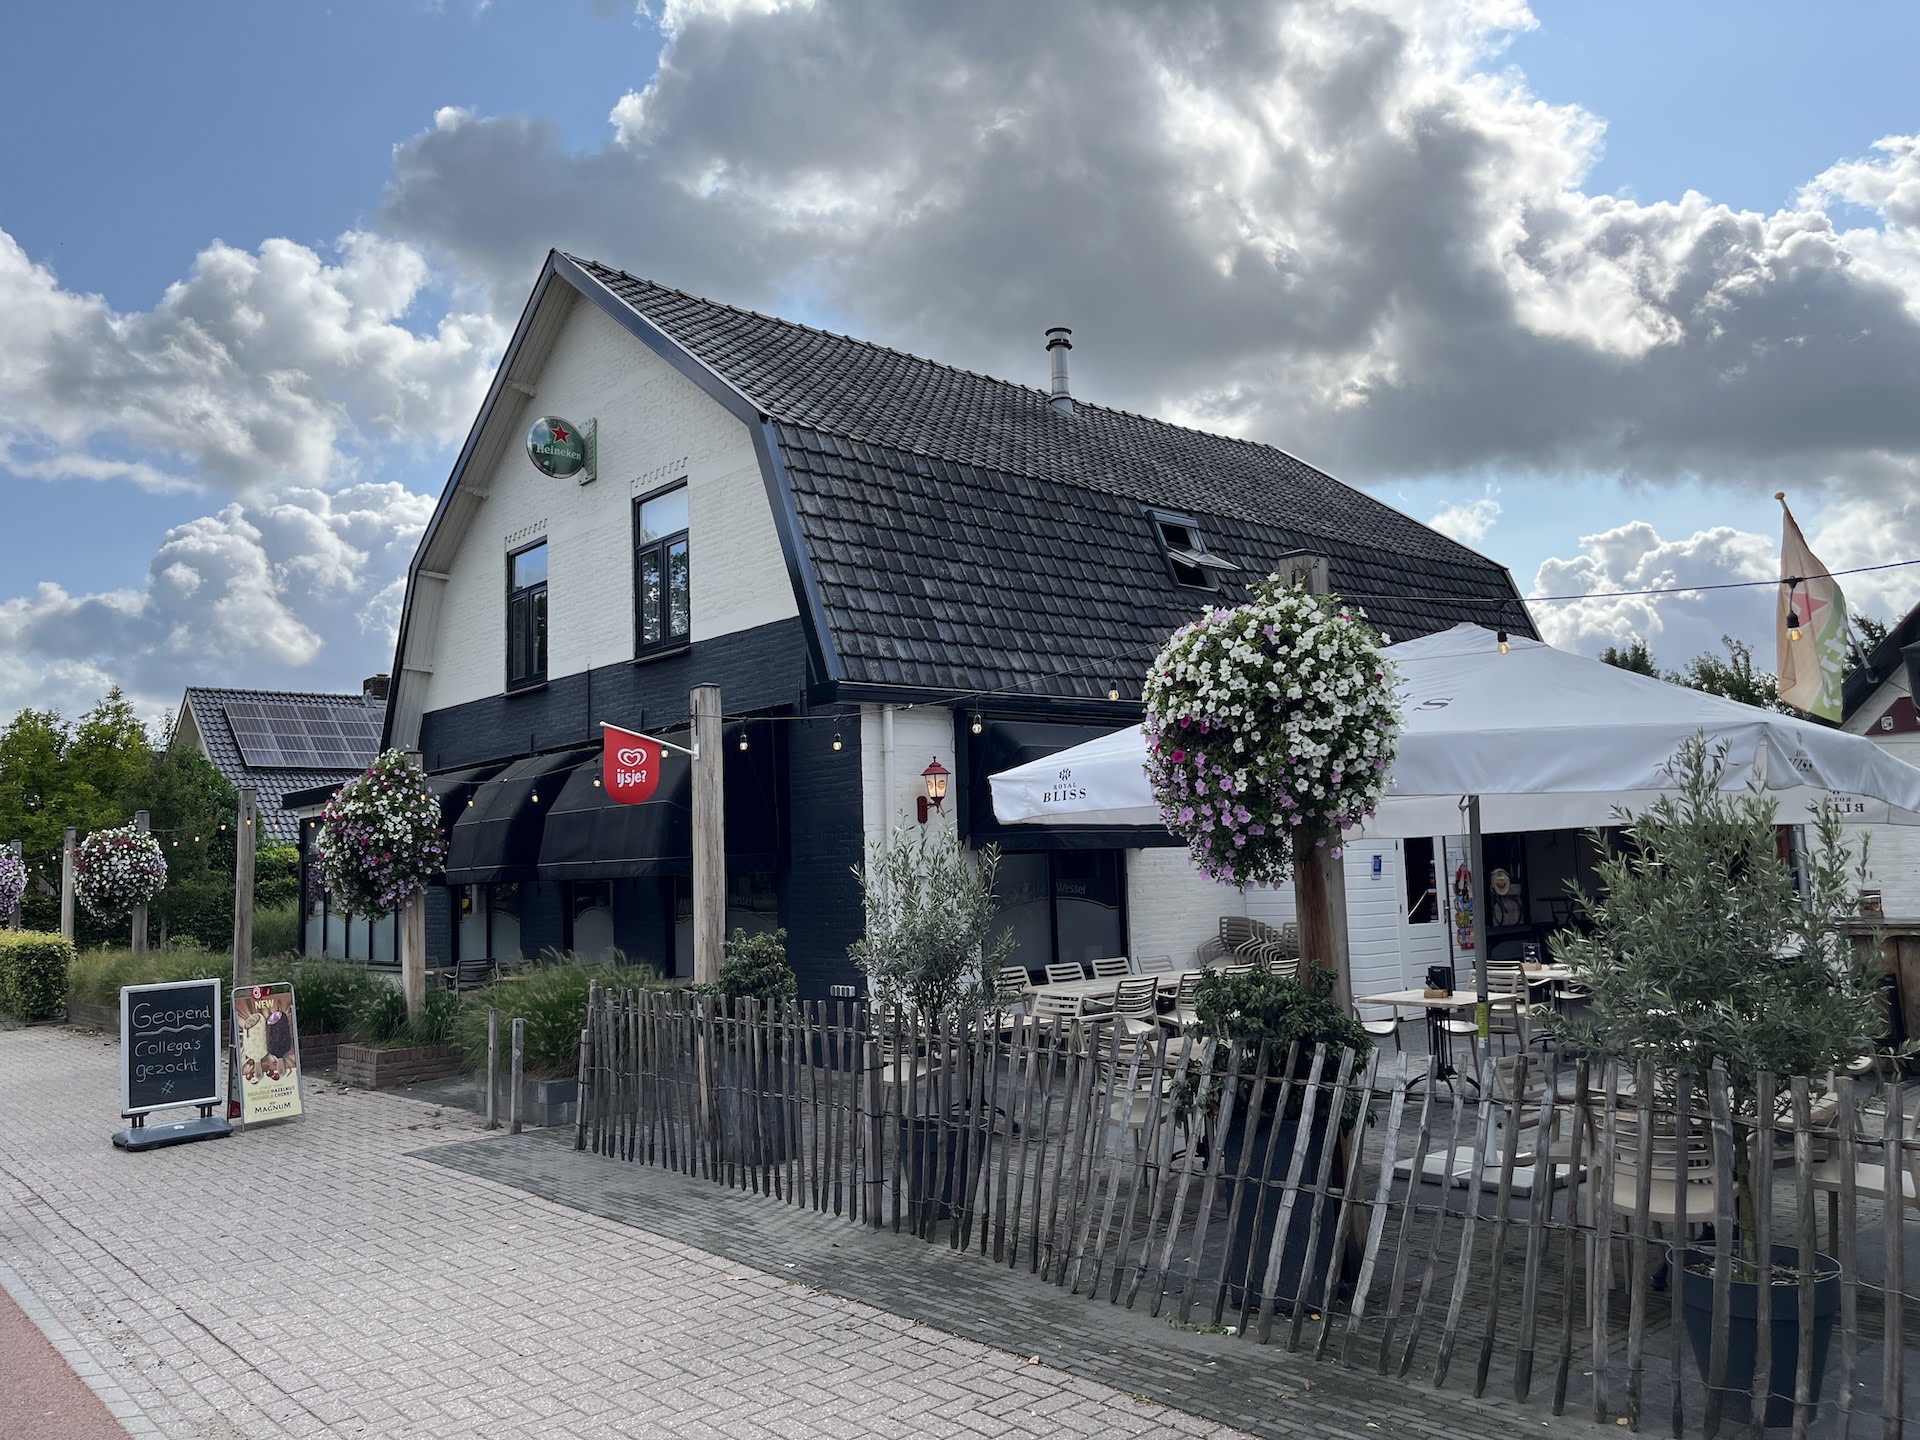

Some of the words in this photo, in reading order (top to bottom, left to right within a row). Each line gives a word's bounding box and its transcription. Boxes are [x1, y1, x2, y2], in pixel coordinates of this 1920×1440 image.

[536, 444, 582, 461] Heineken
[616, 768, 647, 788] ijsje?
[1053, 782, 1077, 791] ROYAL
[1043, 788, 1087, 803] BLISS
[1055, 882, 1086, 895] Wessel
[254, 999, 275, 1010] NEW
[132, 1002, 211, 1029] Geopend
[134, 1038, 201, 1057] Collega's
[135, 1058, 200, 1083] gezocht
[254, 1101, 292, 1114] MAGNUM
